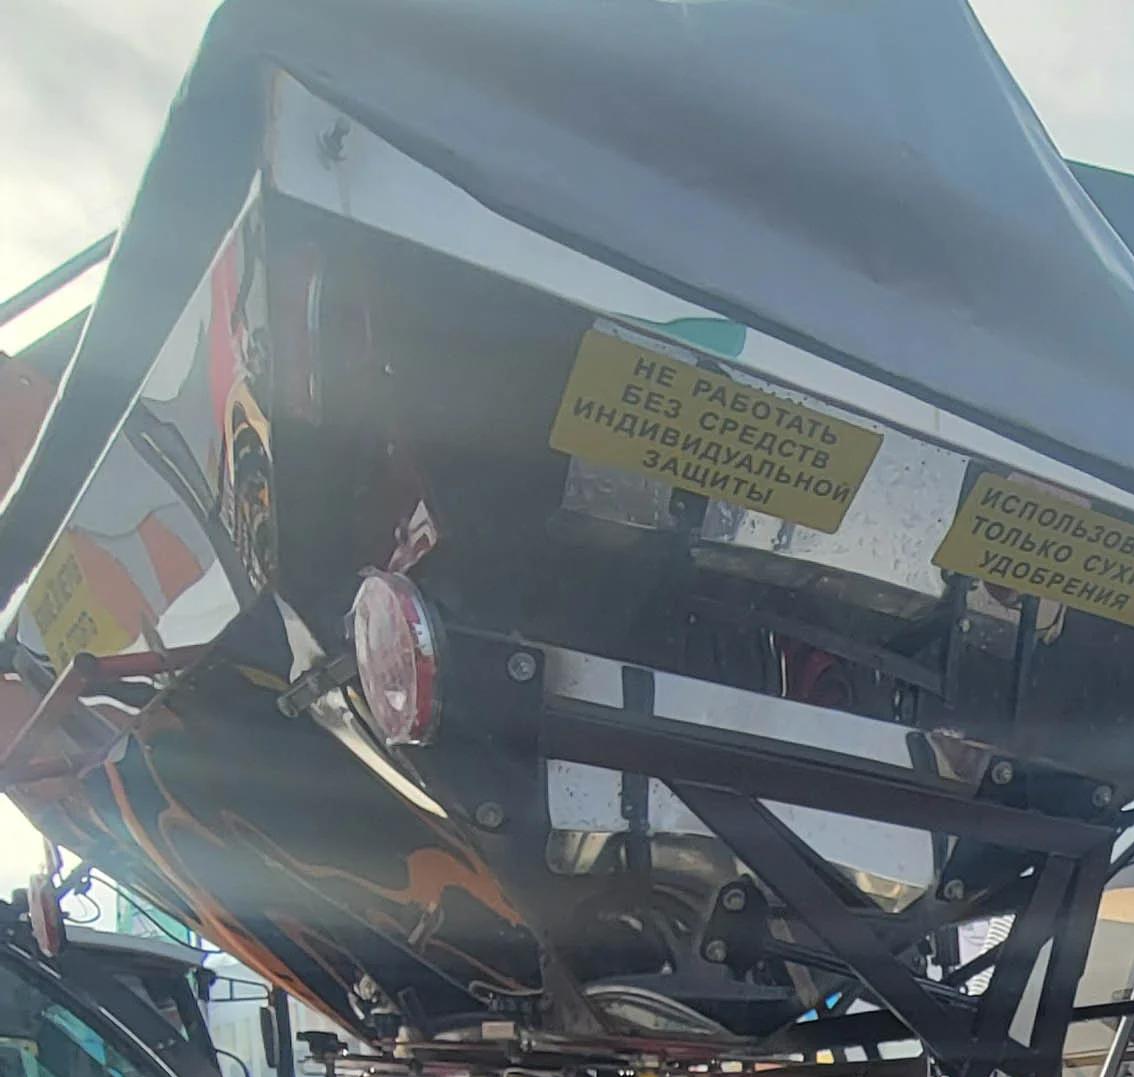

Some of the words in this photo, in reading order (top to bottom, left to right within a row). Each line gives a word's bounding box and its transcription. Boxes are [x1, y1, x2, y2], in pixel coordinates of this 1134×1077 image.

[622, 384, 683, 419] БЕЗ
[700, 411, 830, 470] СРЕДСТВ
[633, 357, 677, 388] НЕ
[691, 379, 838, 446] РАБОТАТЬ
[573, 396, 851, 504] ИНДИВИДУАЛЬНОЙ
[643, 449, 774, 505] ЗАЩИТЫ
[971, 515, 1073, 563] ТОЛЬКО
[979, 550, 1130, 611] УДОБРЕНИЯ
